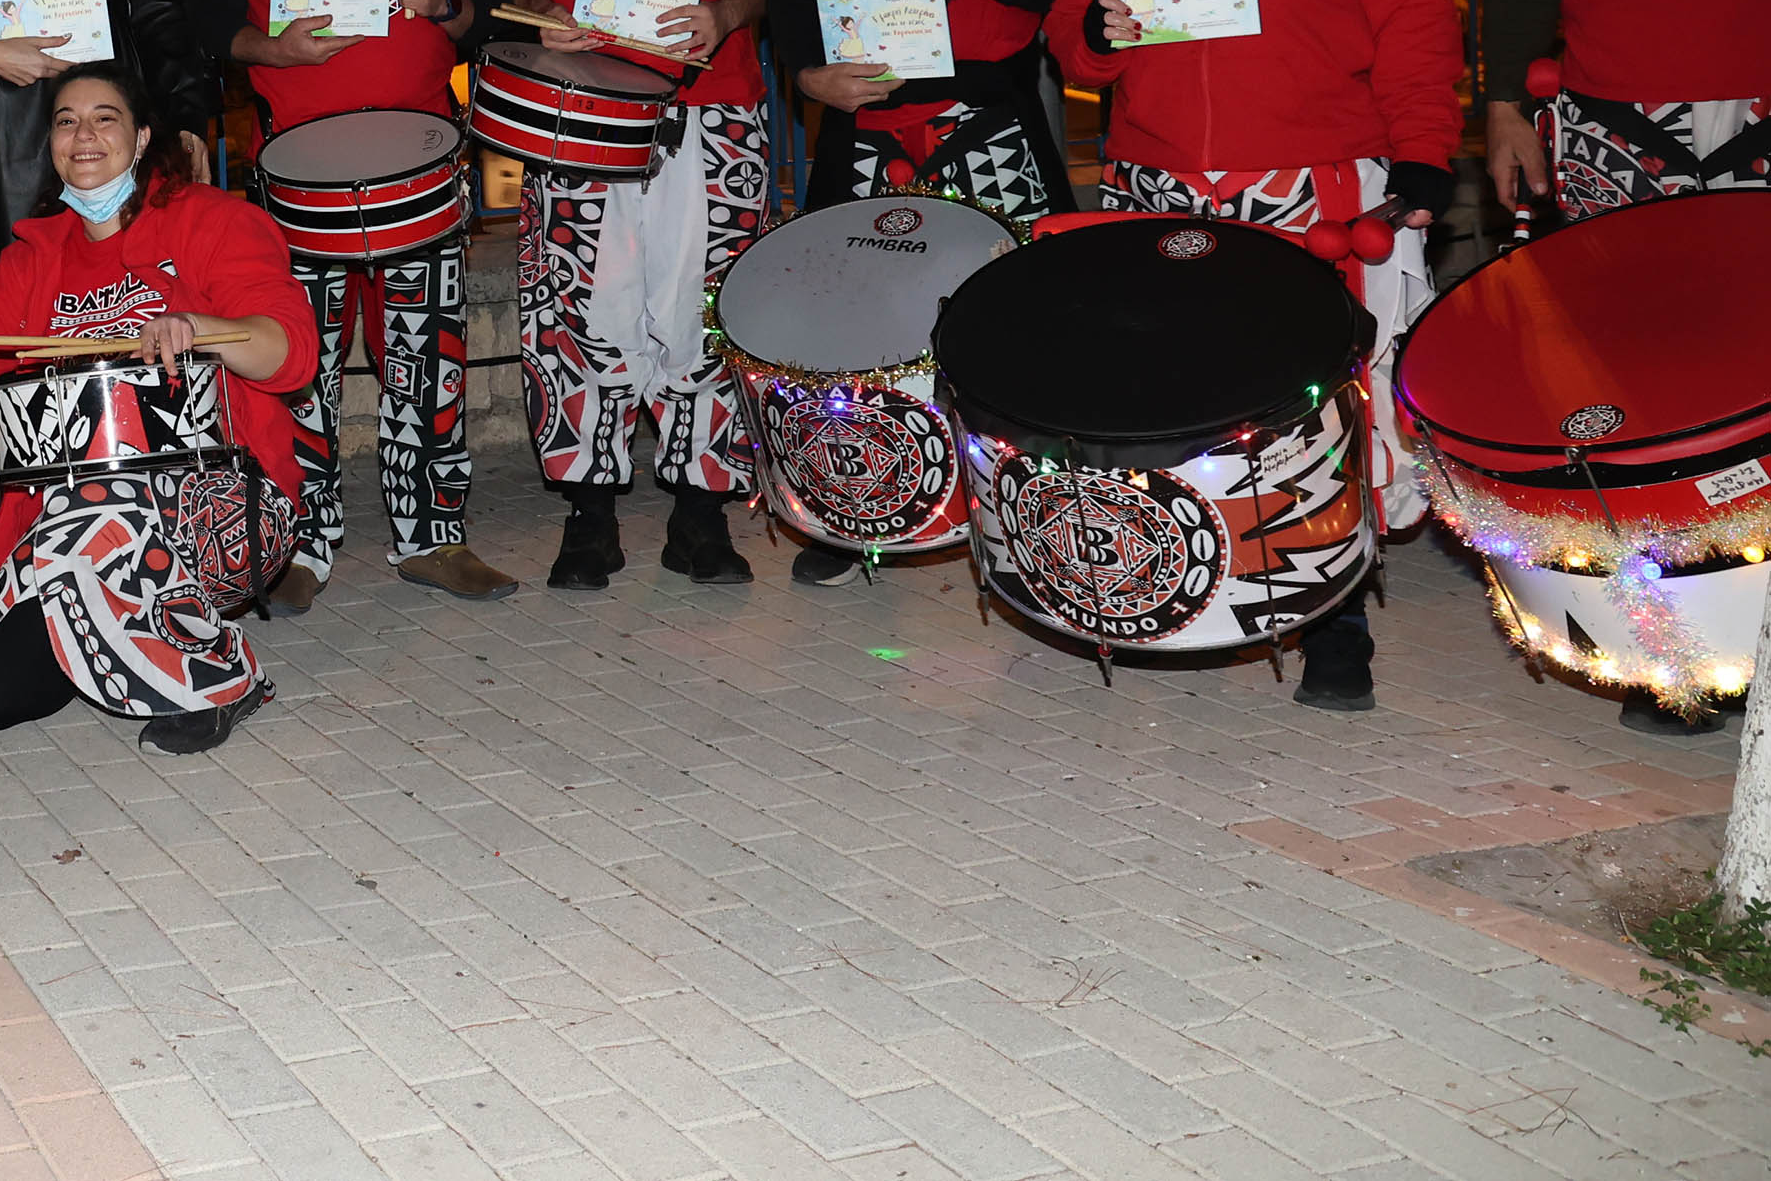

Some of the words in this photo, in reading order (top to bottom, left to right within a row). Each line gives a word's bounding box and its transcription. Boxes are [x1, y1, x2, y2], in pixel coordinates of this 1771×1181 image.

[577, 98, 595, 110] 13
[846, 236, 928, 253] TIMBRA
[824, 510, 906, 535] MUNDO
[1058, 601, 1159, 635] MUNDO
